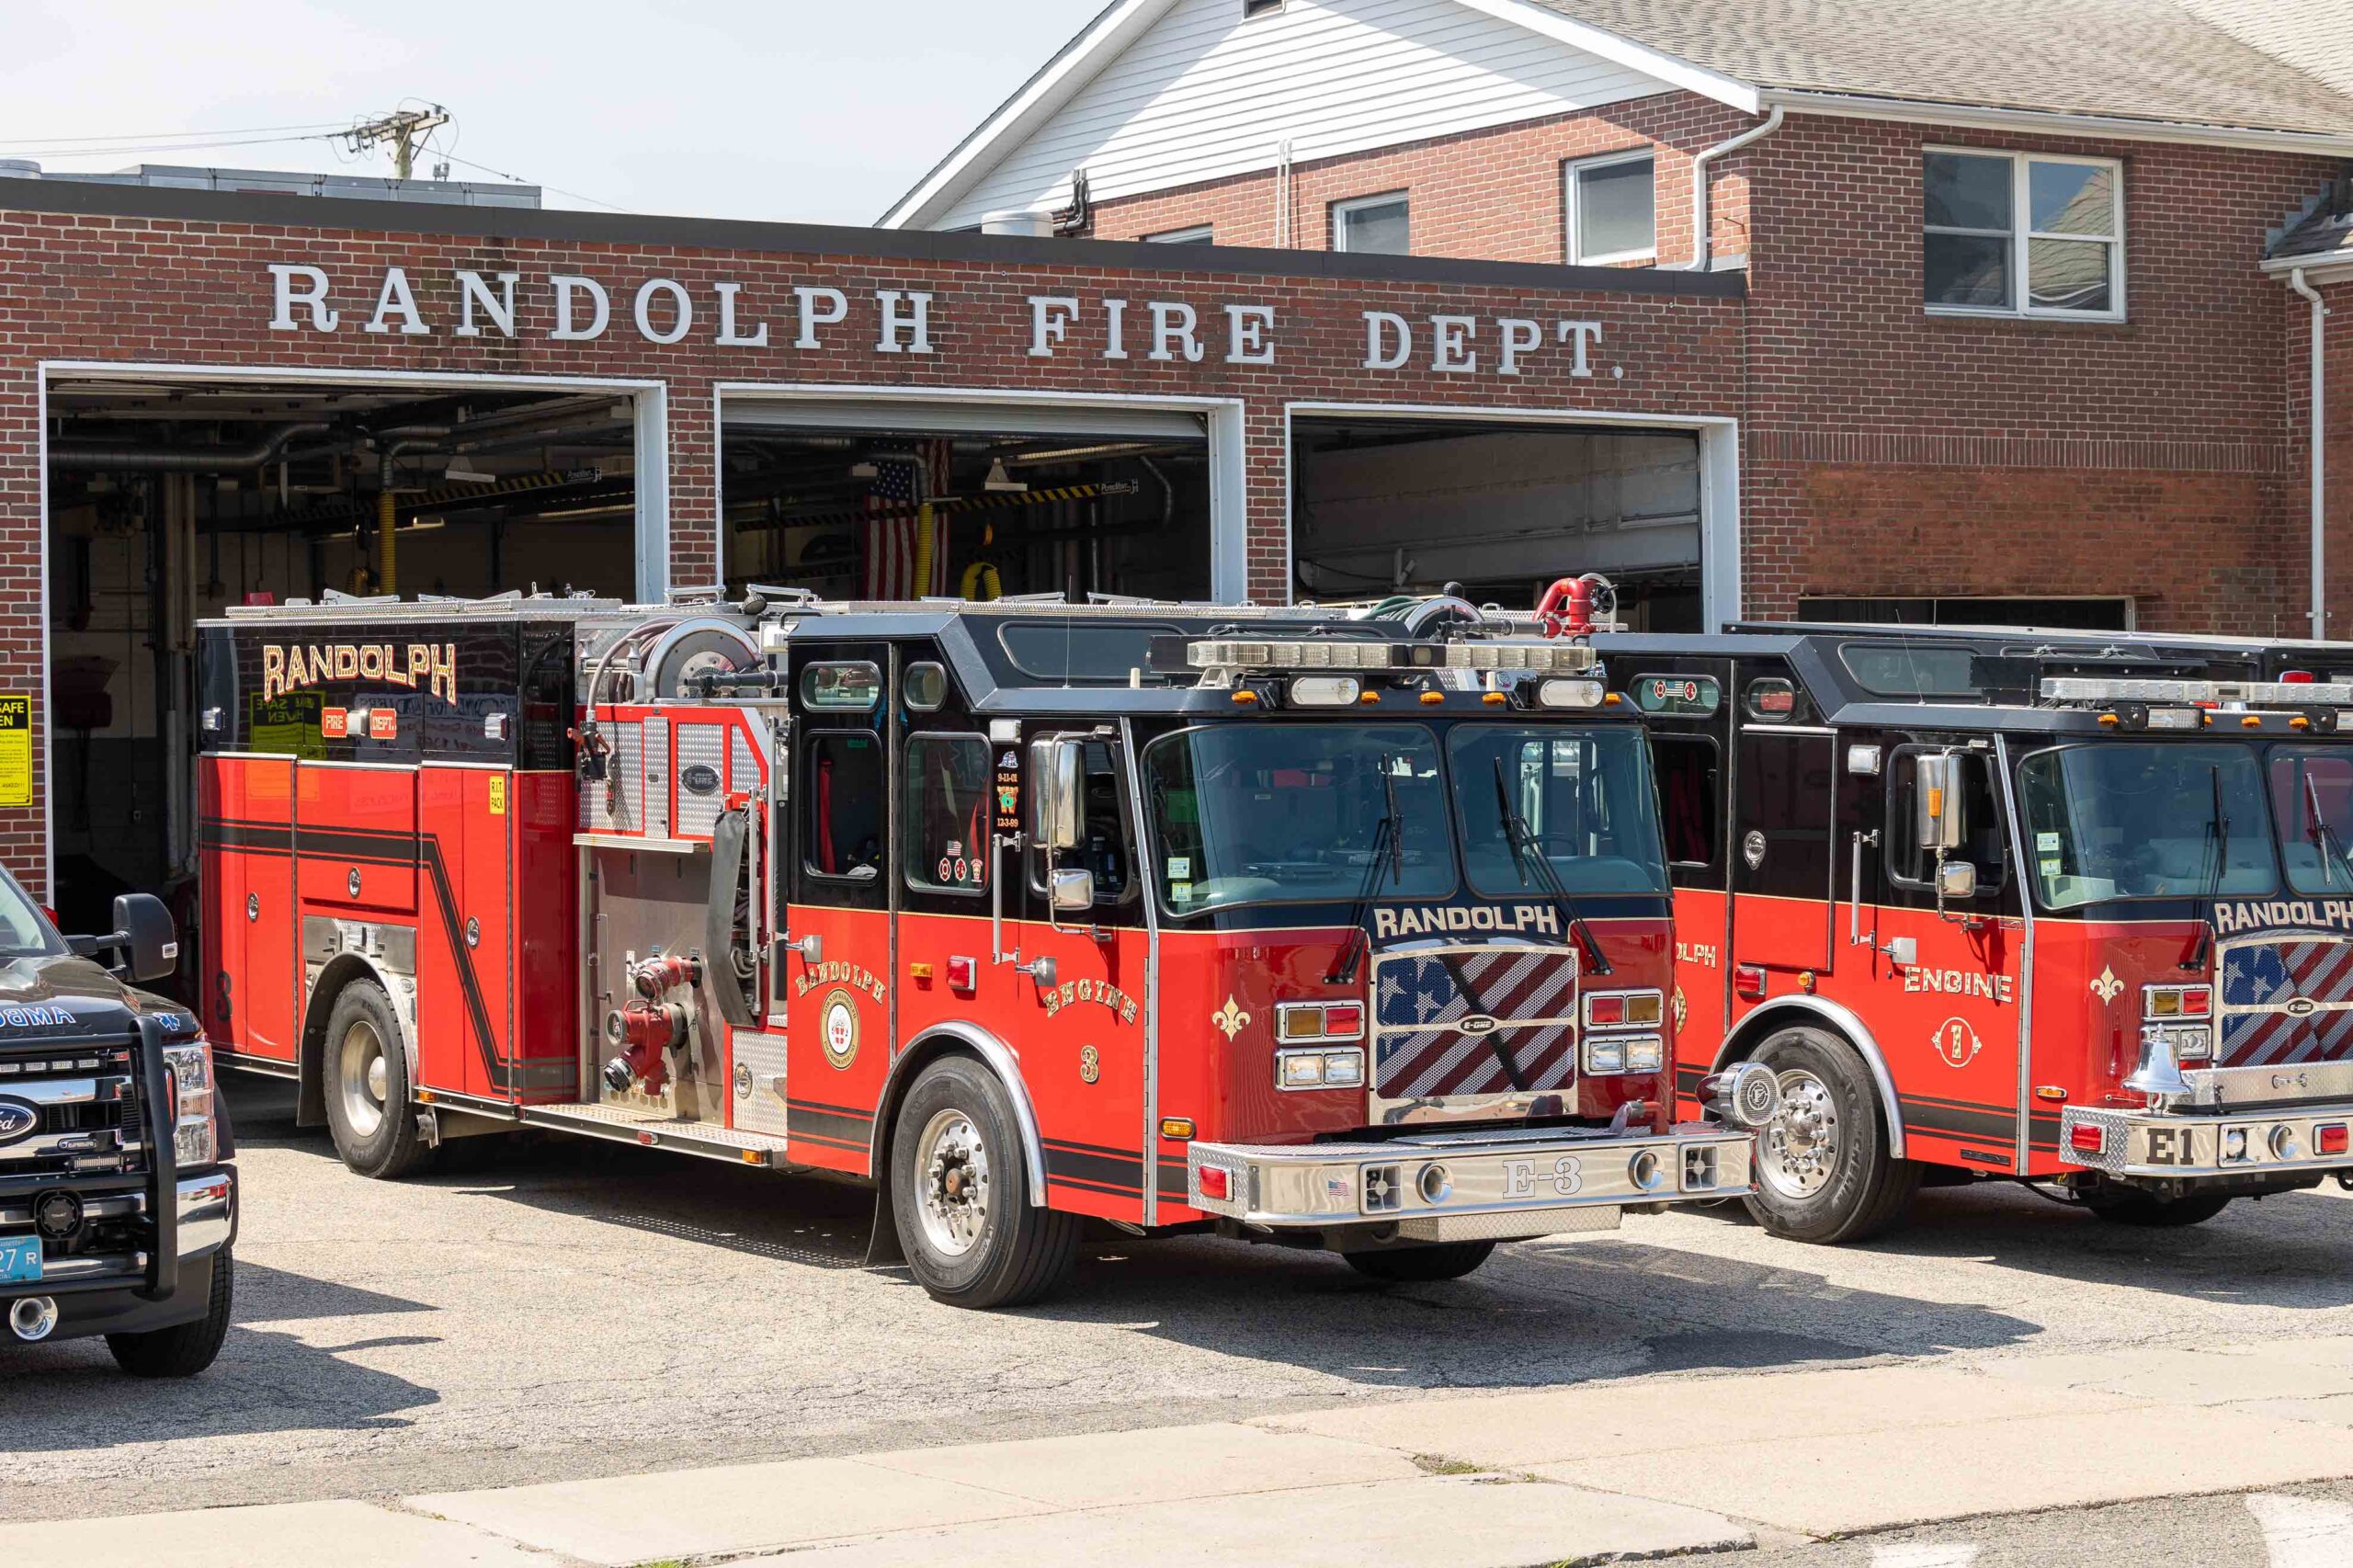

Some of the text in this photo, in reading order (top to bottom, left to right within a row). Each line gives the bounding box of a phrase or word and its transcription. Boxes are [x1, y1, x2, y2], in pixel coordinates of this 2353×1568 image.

[267, 263, 1625, 380] RANDOLPH FIRE DEPT.
[263, 644, 456, 706] RANDOLPH
[325, 714, 395, 731] FIRE DEPT.
[1001, 791, 1015, 808] 6
[1373, 905, 1559, 938] RANDOLPH
[2214, 901, 2353, 934] RANDOLPH
[215, 971, 233, 1022] 3
[795, 960, 886, 1006] RANDOLPH
[1042, 978, 1138, 1025] ENGINE
[1904, 966, 2013, 1004] ENGINE
[1950, 1024, 1963, 1059] 1
[1080, 1045, 1099, 1084] 3
[2146, 1128, 2194, 1165] E1
[1503, 1155, 1583, 1199] E-3
[26, 1251, 37, 1266] R
